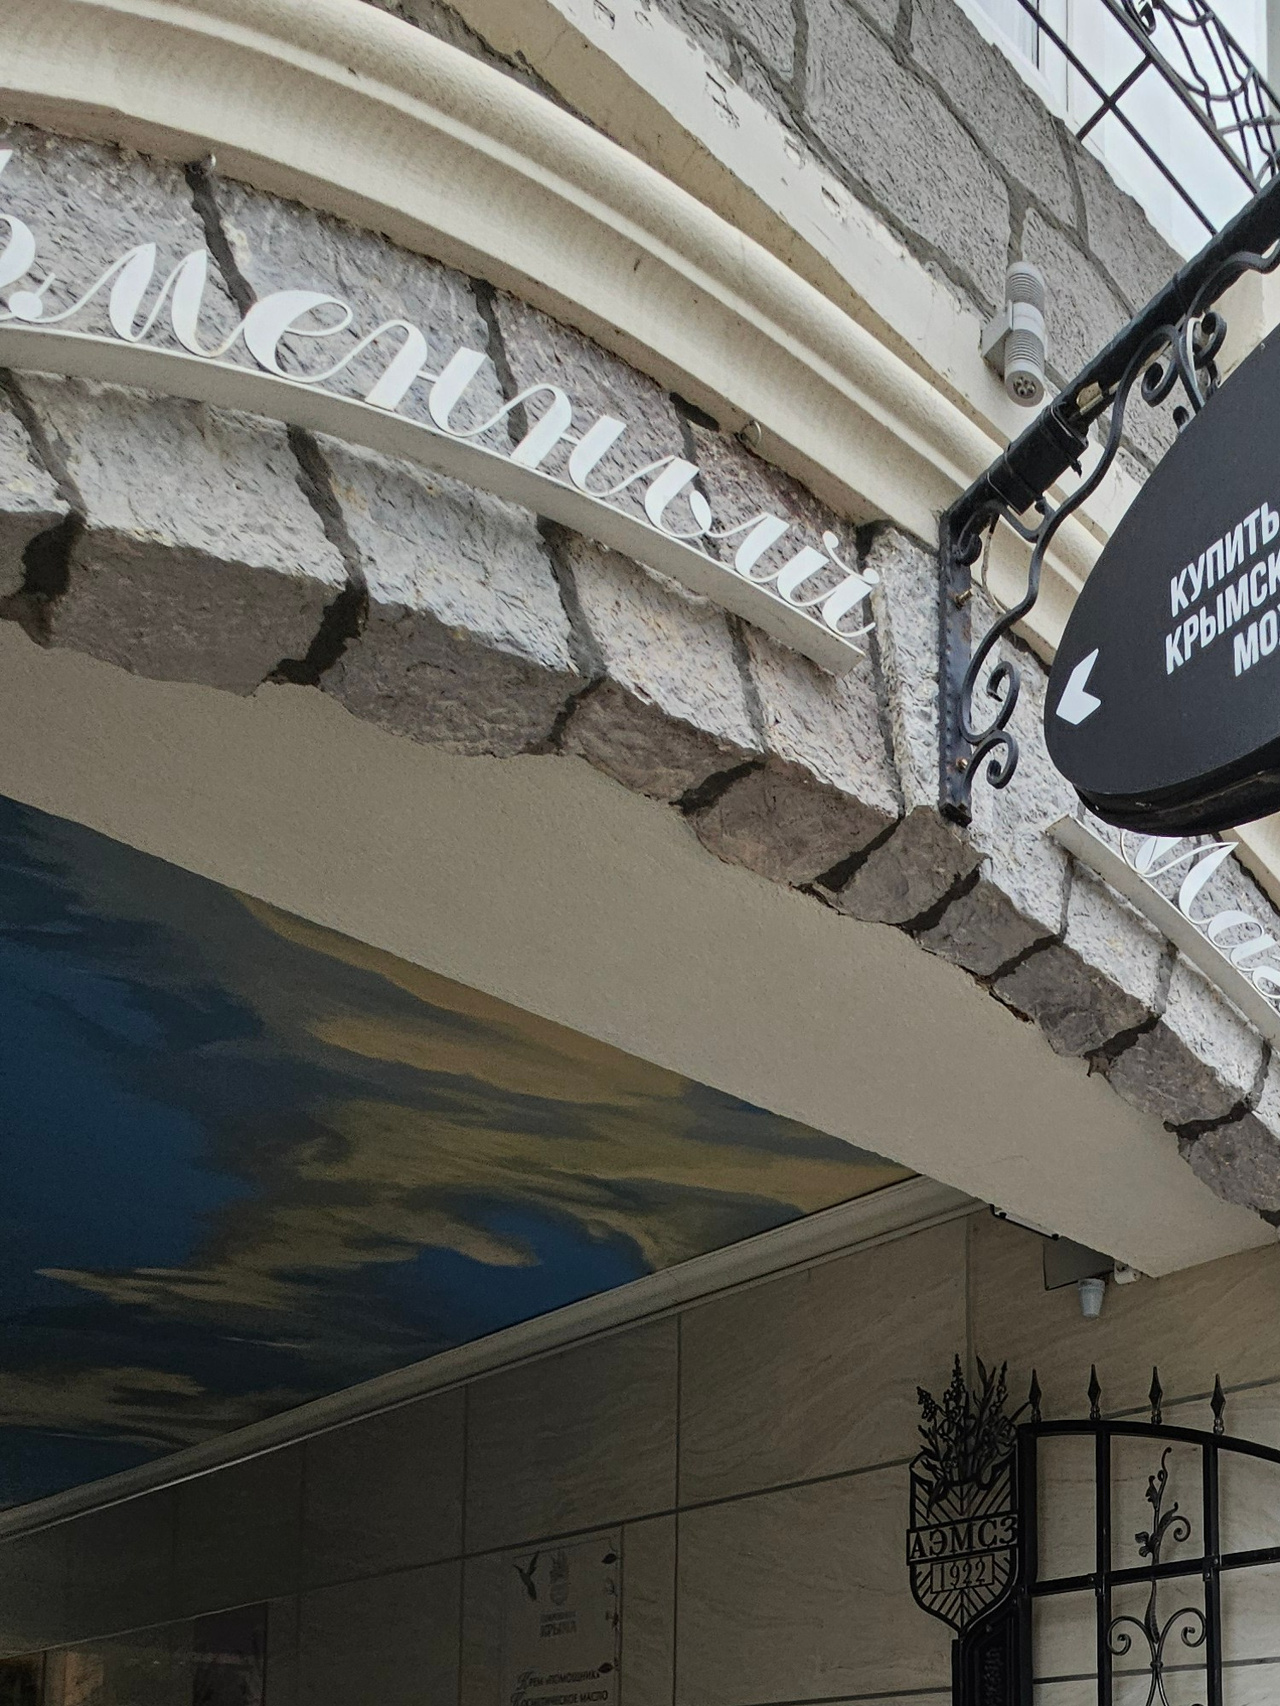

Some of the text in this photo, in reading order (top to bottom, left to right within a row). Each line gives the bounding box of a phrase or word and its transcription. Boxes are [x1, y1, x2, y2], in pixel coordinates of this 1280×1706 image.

[1170, 502, 1280, 618] КУПИТЬ
[911, 1517, 1017, 1558] АЭМСЗ
[940, 1557, 986, 1590] 1922
